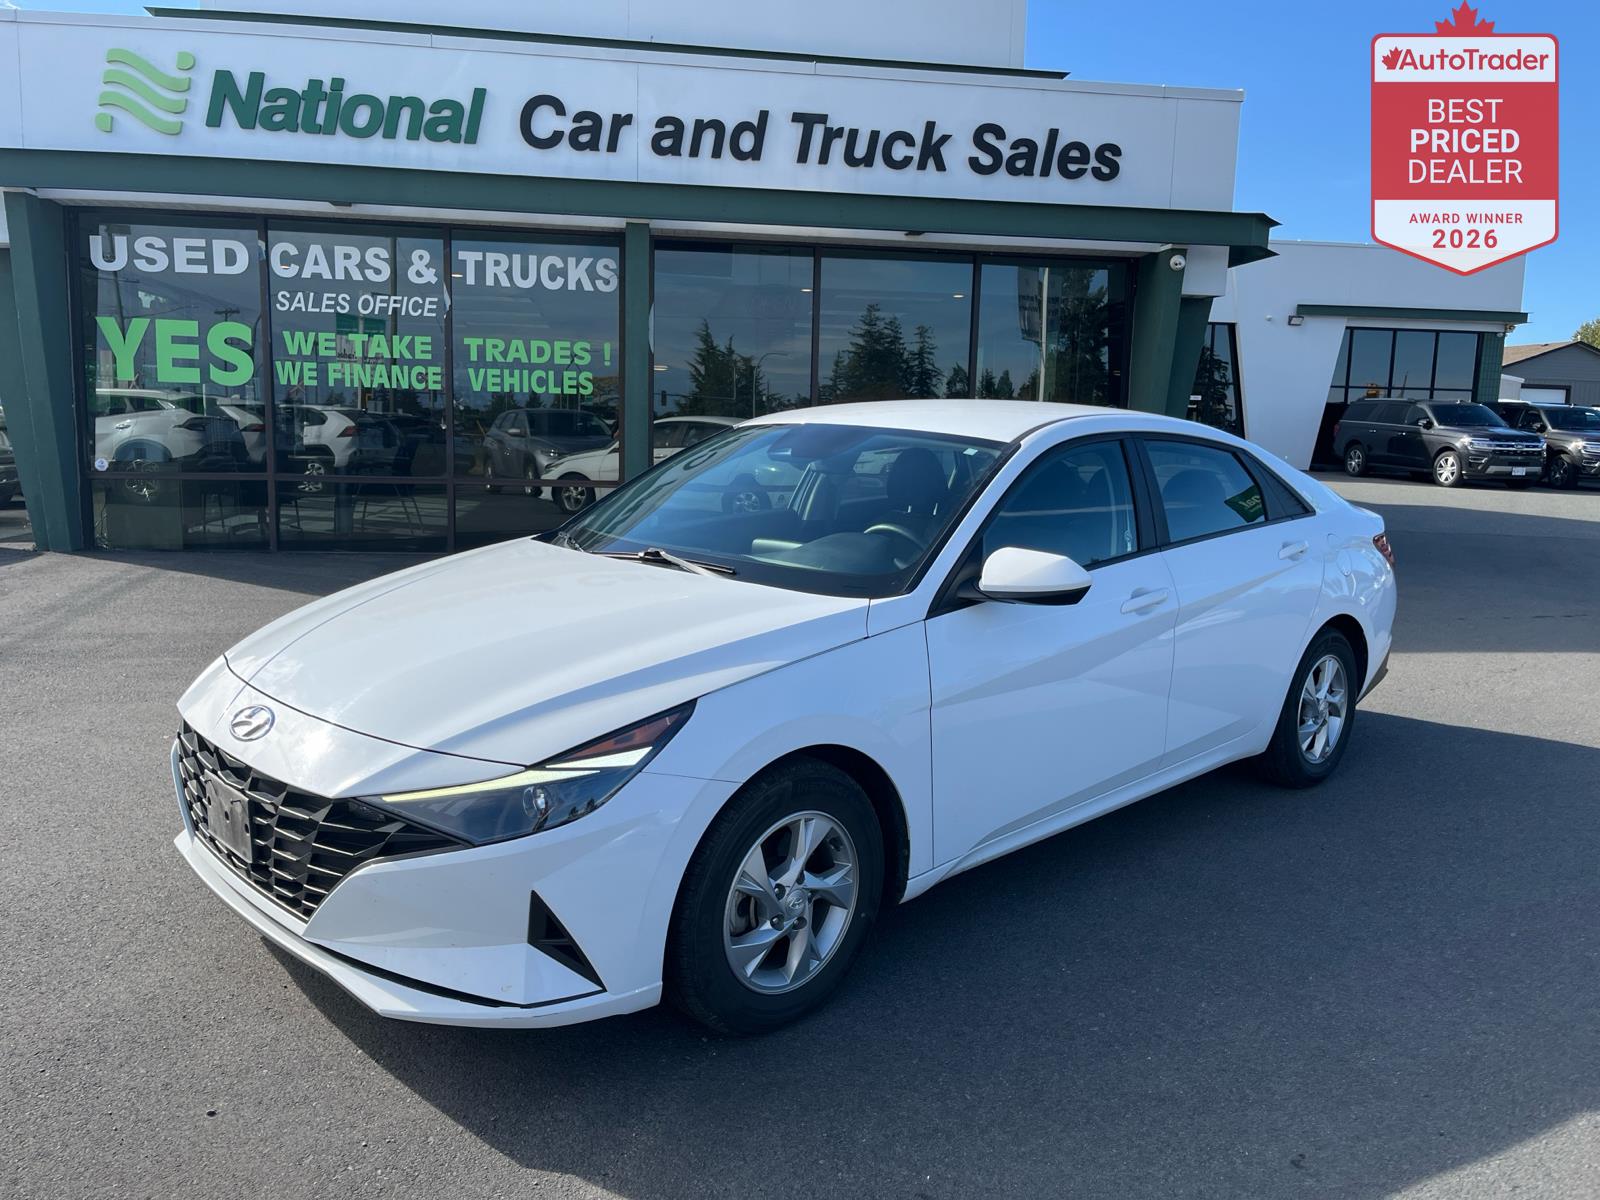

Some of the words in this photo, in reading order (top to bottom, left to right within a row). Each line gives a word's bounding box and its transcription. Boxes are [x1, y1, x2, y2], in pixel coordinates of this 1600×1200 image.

[206, 70, 486, 144] National
[520, 95, 633, 152] Car
[651, 110, 769, 161] and
[791, 112, 952, 172] Truck
[968, 122, 1123, 181] Sales
[89, 235, 249, 275] USED
[270, 242, 391, 283] CARS
[408, 249, 438, 285] &
[458, 250, 618, 292] TRUCKS
[275, 291, 351, 314] SALES
[358, 294, 438, 317] OFFICE
[96, 316, 254, 386] YES
[283, 331, 336, 355] WE
[348, 333, 431, 359] TAKE
[464, 337, 591, 365] TRADES
[275, 361, 319, 385] WE
[328, 363, 442, 390] FINANCE
[468, 367, 593, 395] VEHICLES
